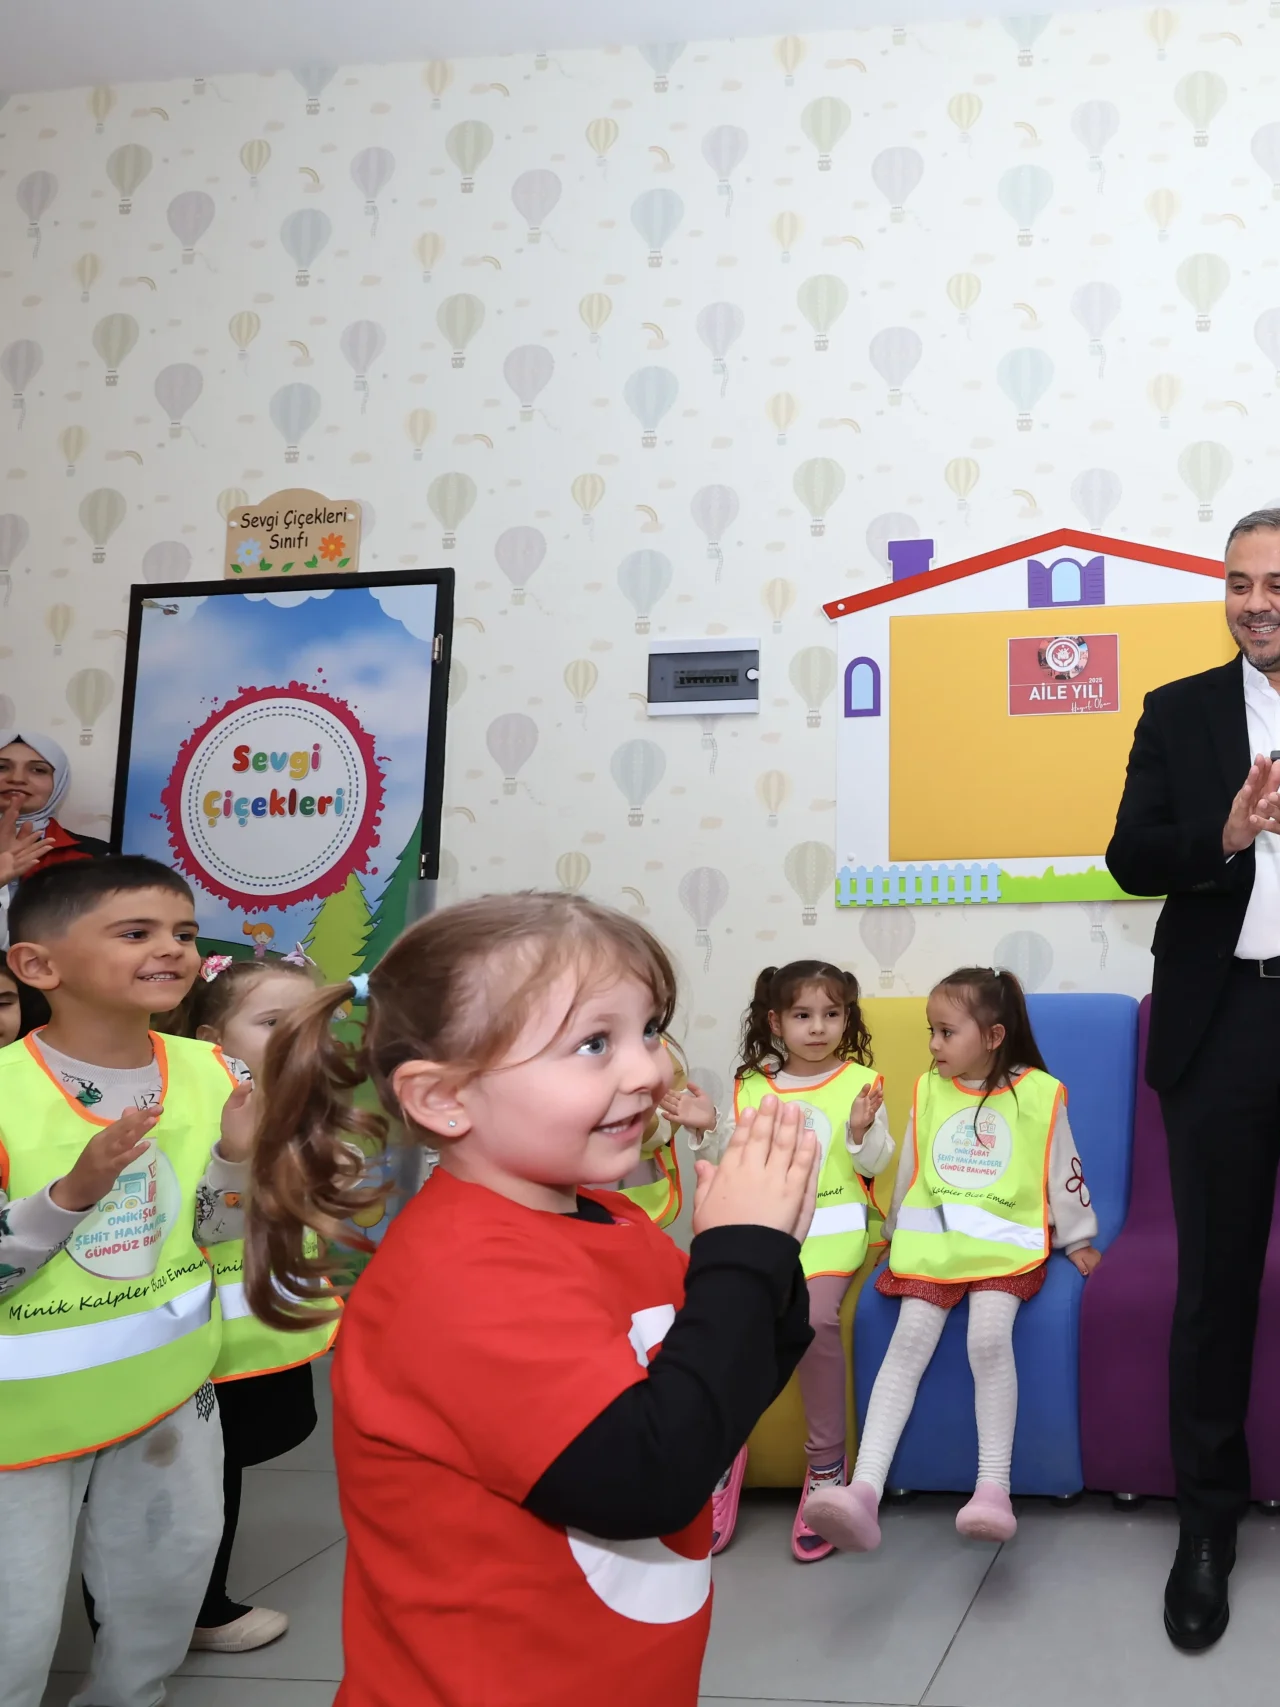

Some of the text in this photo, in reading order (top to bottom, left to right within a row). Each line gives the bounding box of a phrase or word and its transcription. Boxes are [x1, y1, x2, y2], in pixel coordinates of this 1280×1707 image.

[240, 507, 348, 532] Sevgi Çiçekleri
[269, 531, 309, 550] Sınıfı
[1029, 682, 1103, 701] AİLE YILI
[232, 742, 323, 780] Sevgi
[202, 787, 346, 828] Çiçekleri
[817, 1185, 845, 1198] manet
[84, 1239, 140, 1259] GÜNDÜZ
[9, 1299, 74, 1322] Minik
[79, 1285, 151, 1310] Kalpler
